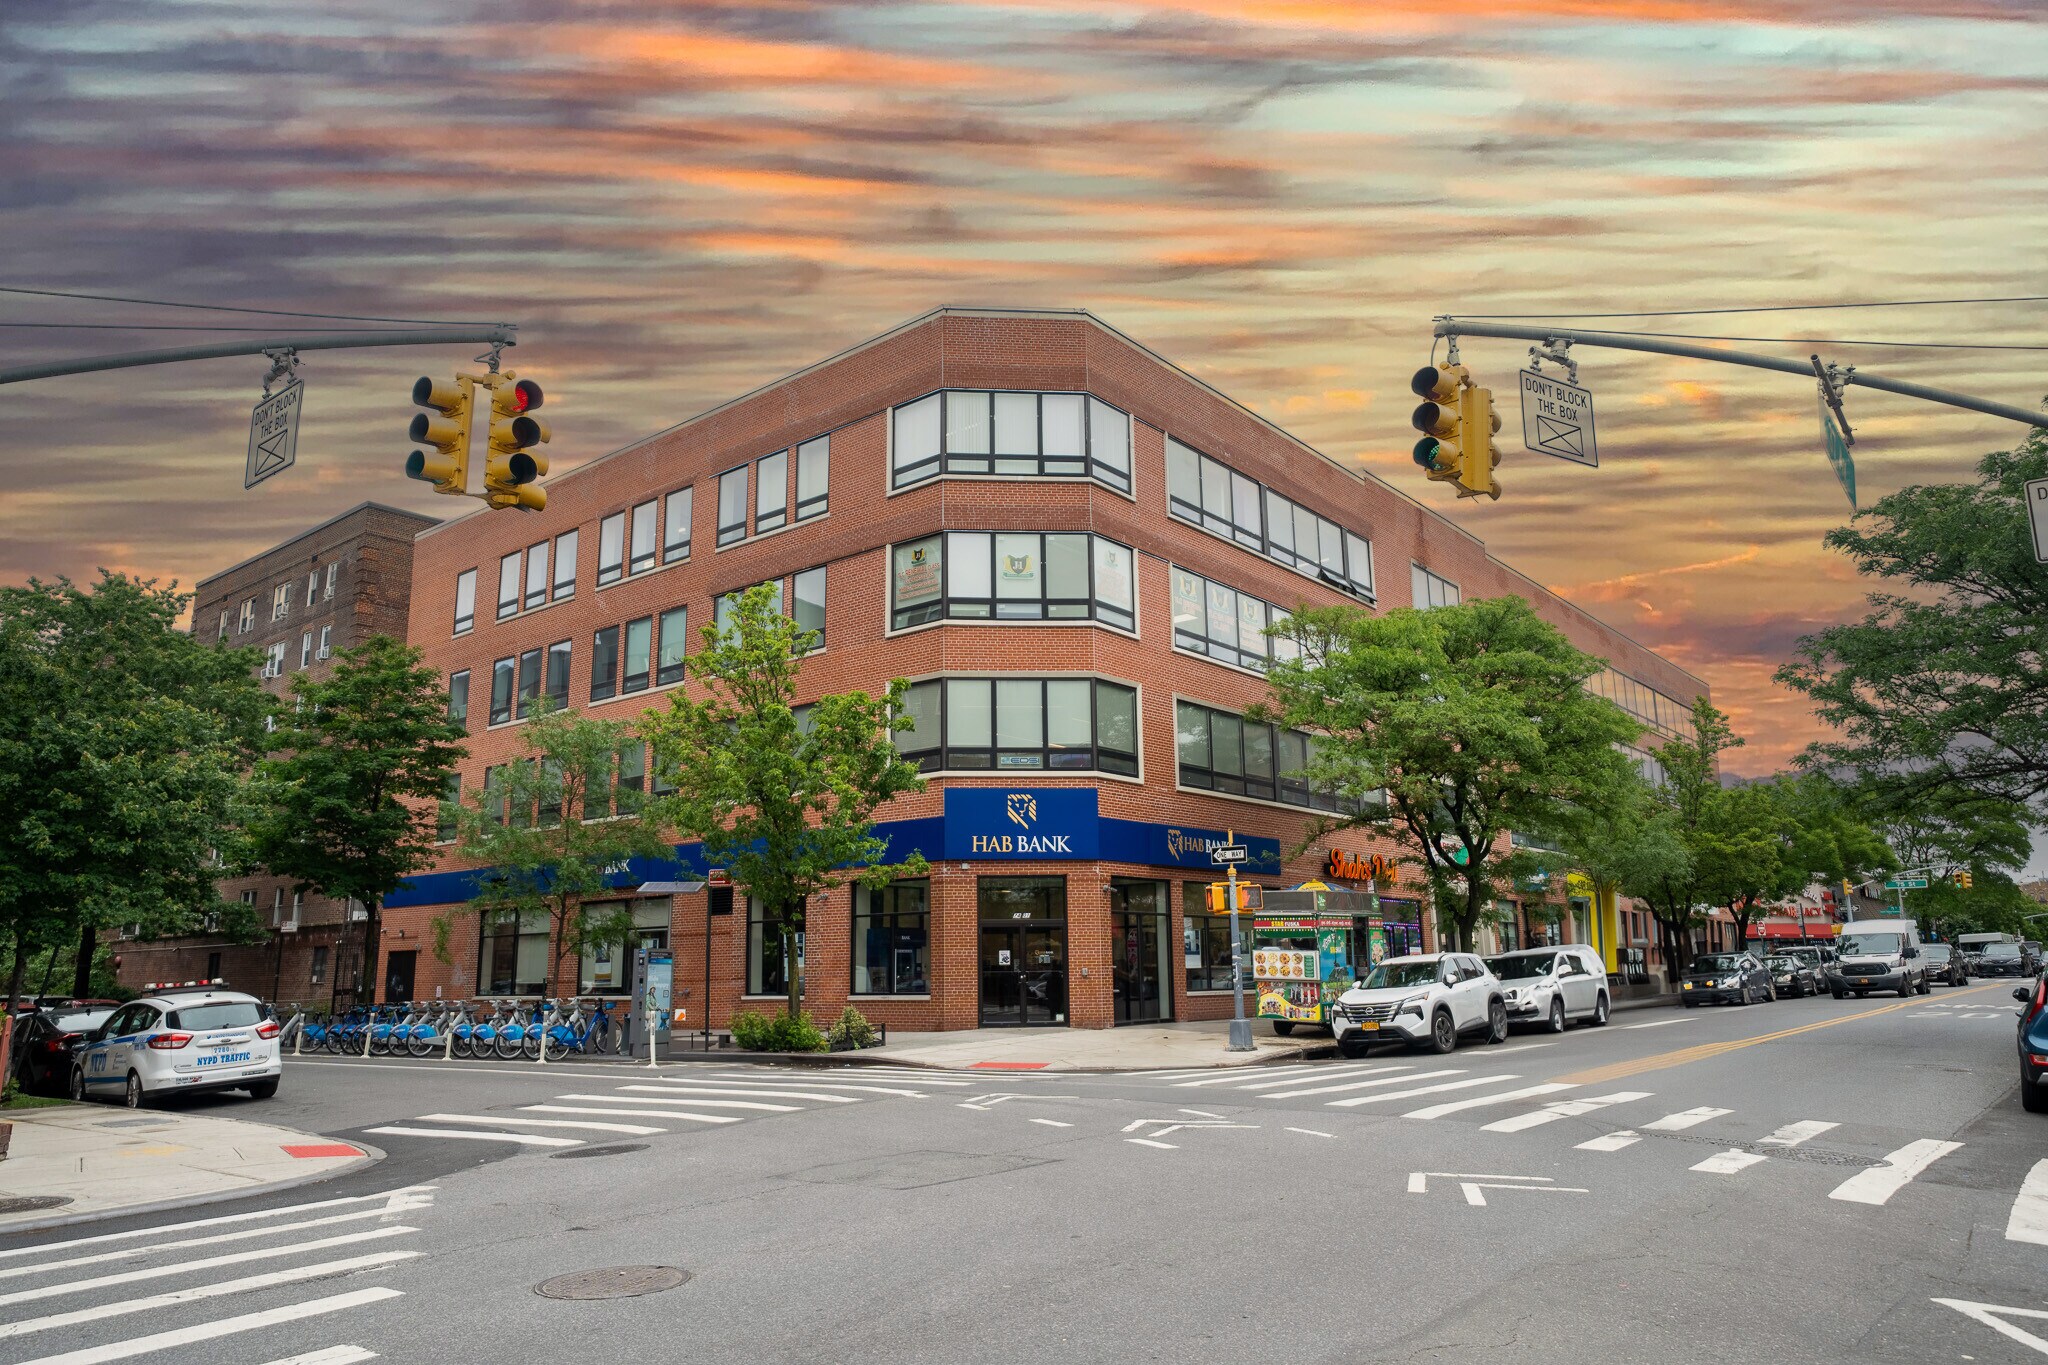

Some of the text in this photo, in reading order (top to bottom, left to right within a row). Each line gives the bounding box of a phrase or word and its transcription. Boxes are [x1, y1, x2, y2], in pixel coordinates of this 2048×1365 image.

[1525, 378, 1587, 408] DON'T BLOCK
[255, 389, 297, 425] DON'T BLOCK
[1538, 398, 1578, 421] THE BOX
[261, 411, 288, 438] THE BOX
[972, 835, 1073, 853] HAB BANK
[1184, 836, 1204, 853] HAB
[1216, 850, 1242, 859] ONE WAY
[1330, 848, 1372, 881] Shah's
[197, 1056, 218, 1066] NYPD
[220, 1052, 251, 1064] TRAFFIC
